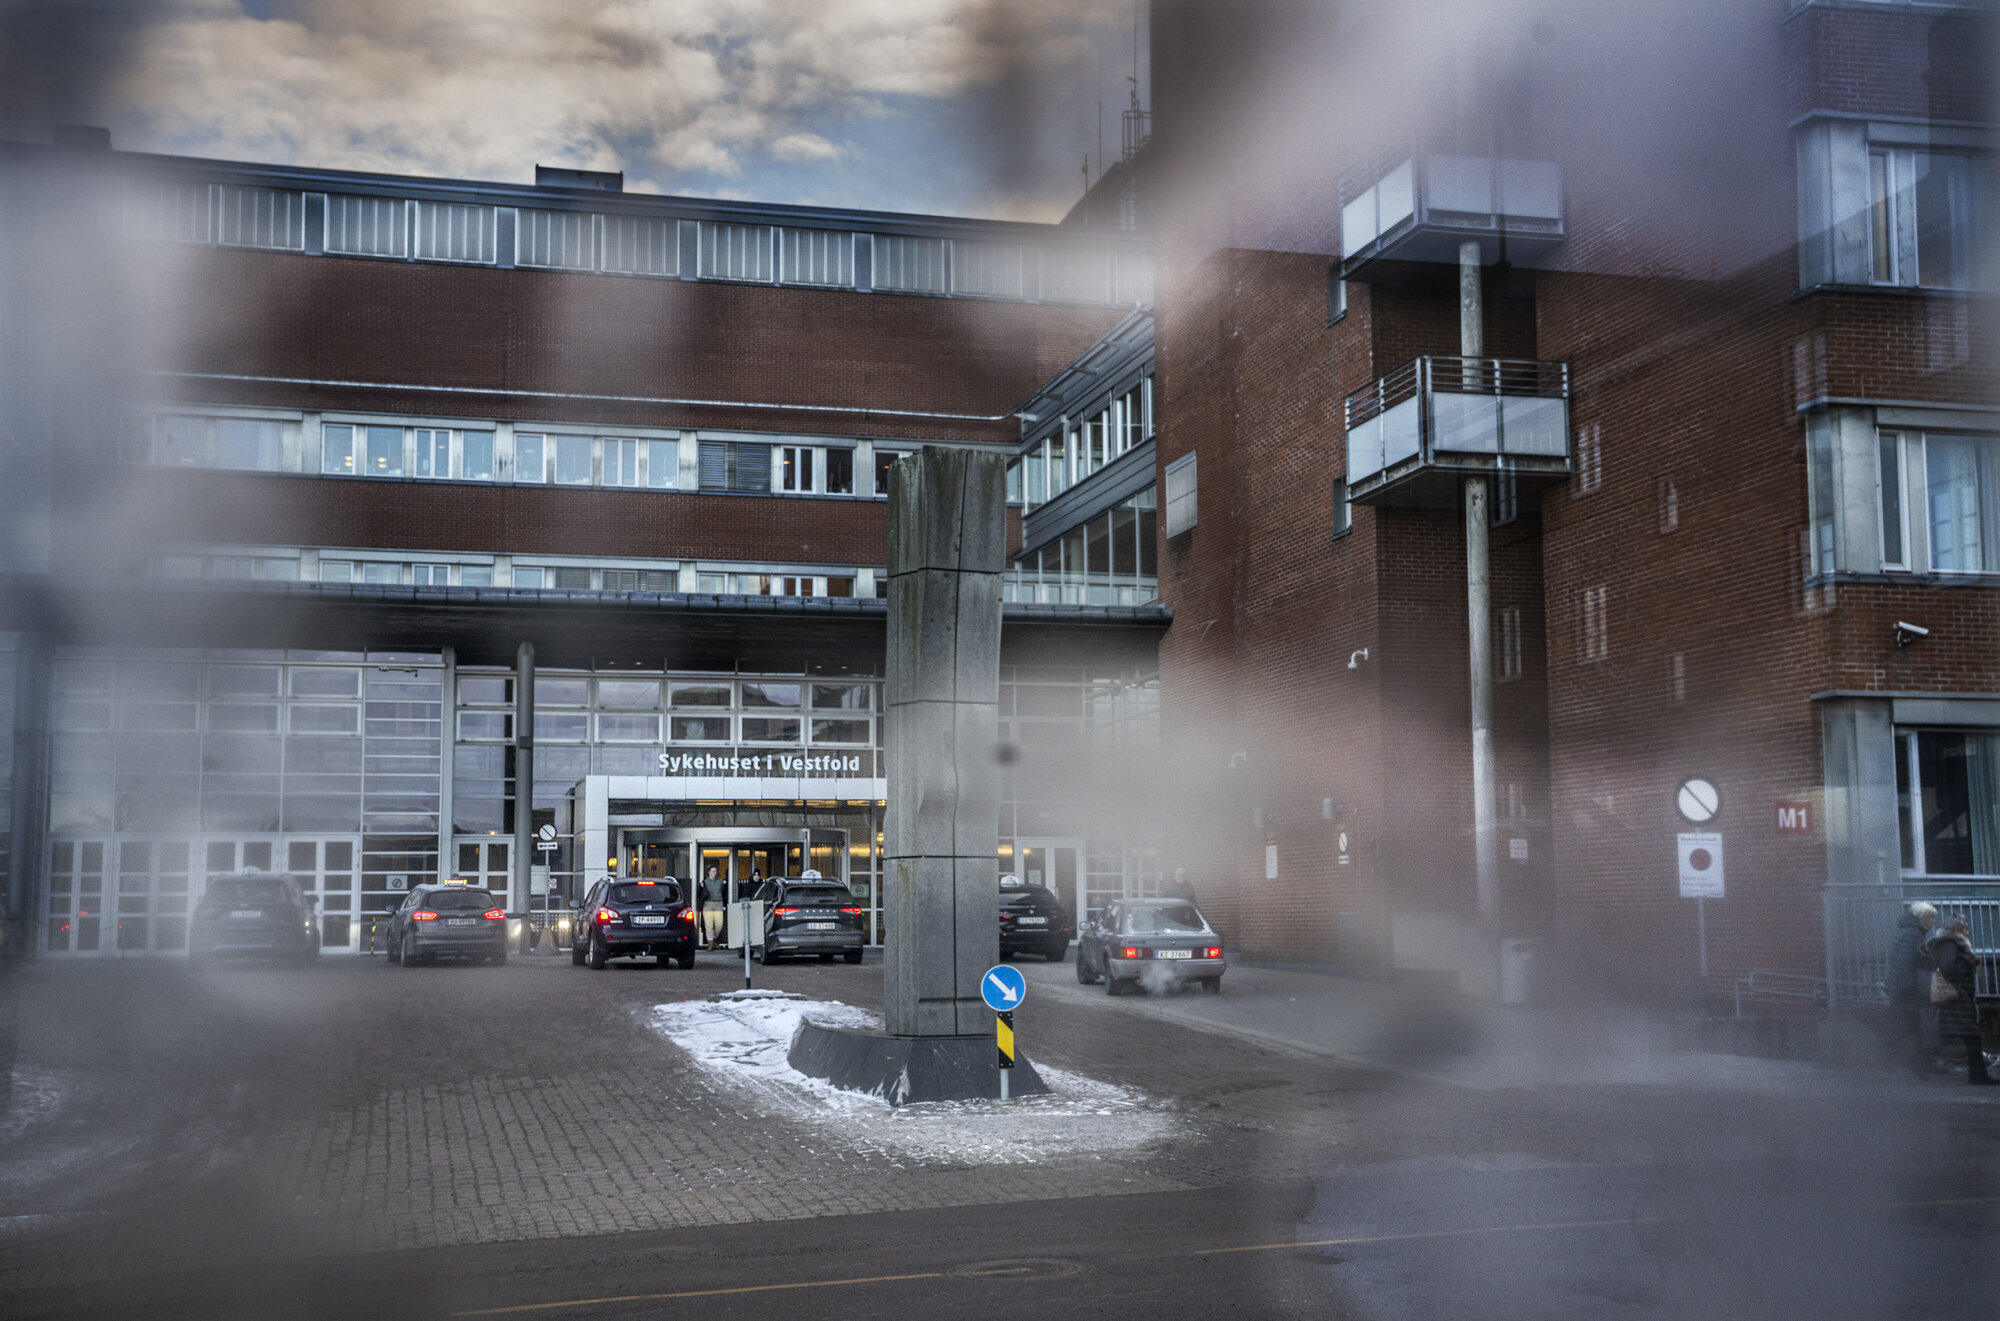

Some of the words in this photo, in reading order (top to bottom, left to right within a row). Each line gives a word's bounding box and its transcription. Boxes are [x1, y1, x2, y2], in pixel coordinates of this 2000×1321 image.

[658, 753, 760, 772] Sykehuset
[766, 754, 773, 770] i
[780, 755, 860, 771] Vestfold
[1778, 807, 1807, 828] M1
